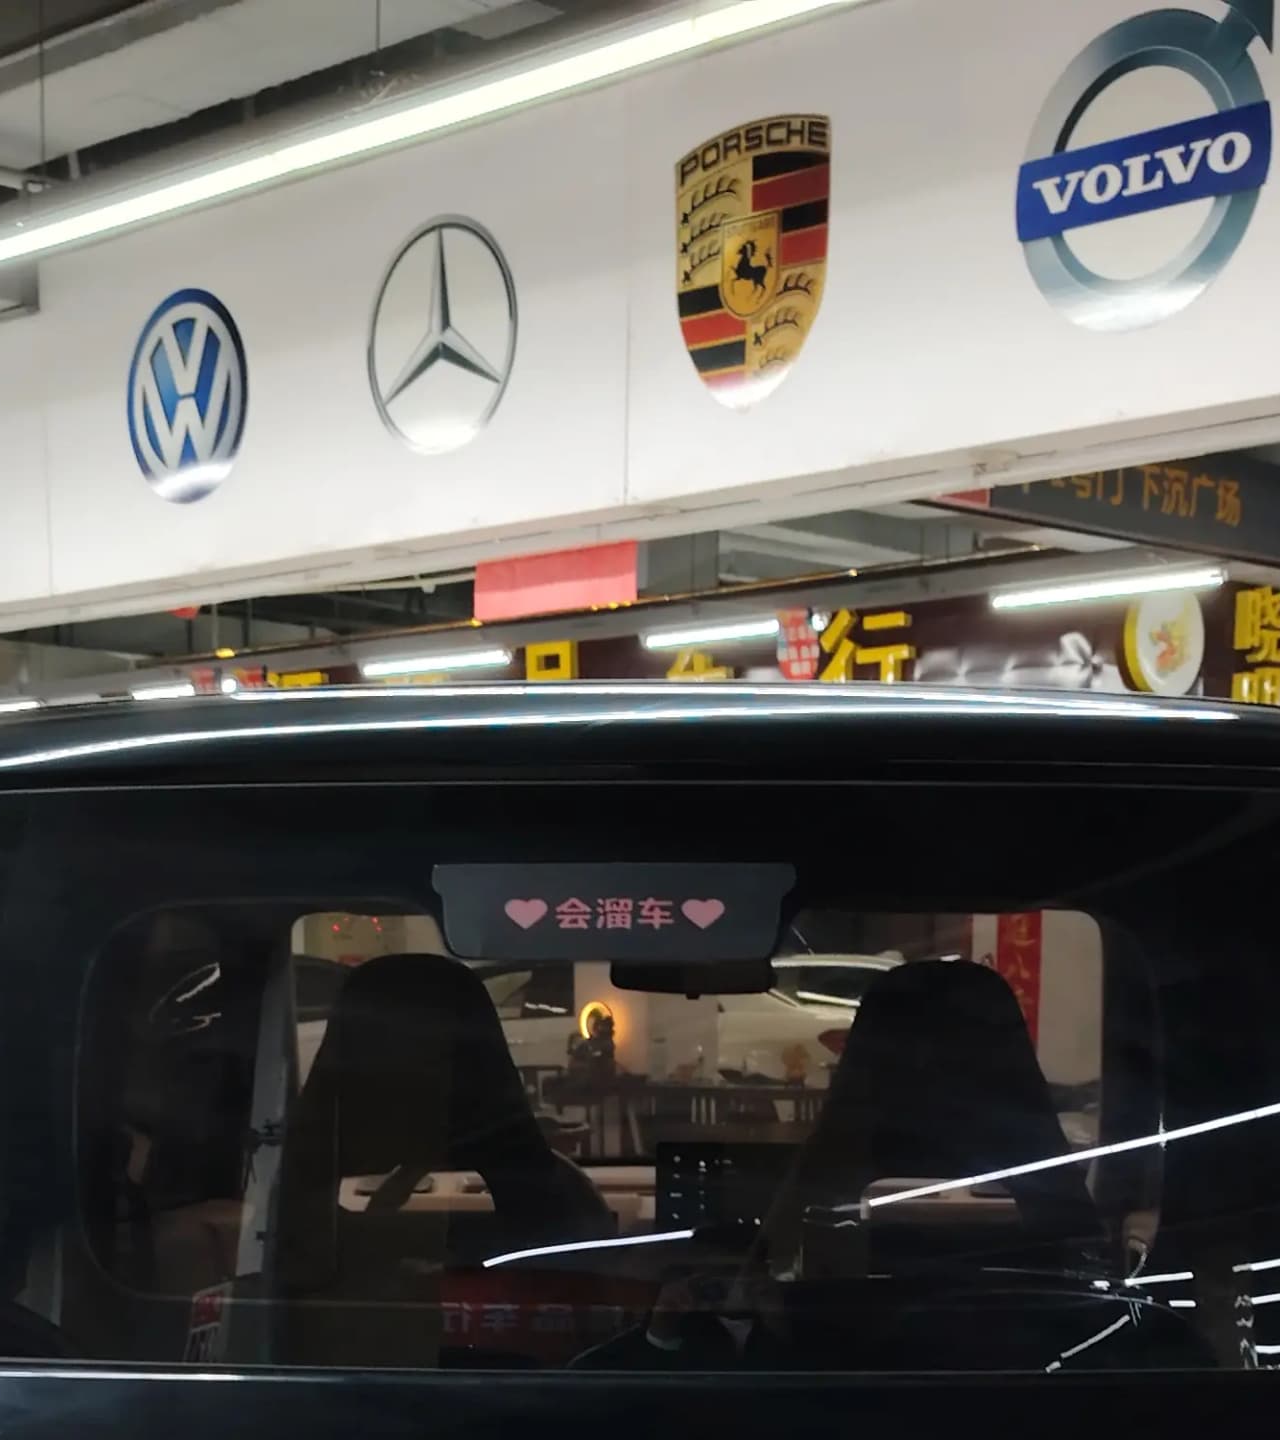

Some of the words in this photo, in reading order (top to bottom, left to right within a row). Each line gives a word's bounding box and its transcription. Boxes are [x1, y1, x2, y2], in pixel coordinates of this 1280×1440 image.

[679, 117, 829, 187] PORSCHE
[1032, 130, 1253, 215] VOLVO
[1139, 463, 1242, 528] 下沉广场
[554, 896, 675, 930] 会溜车
